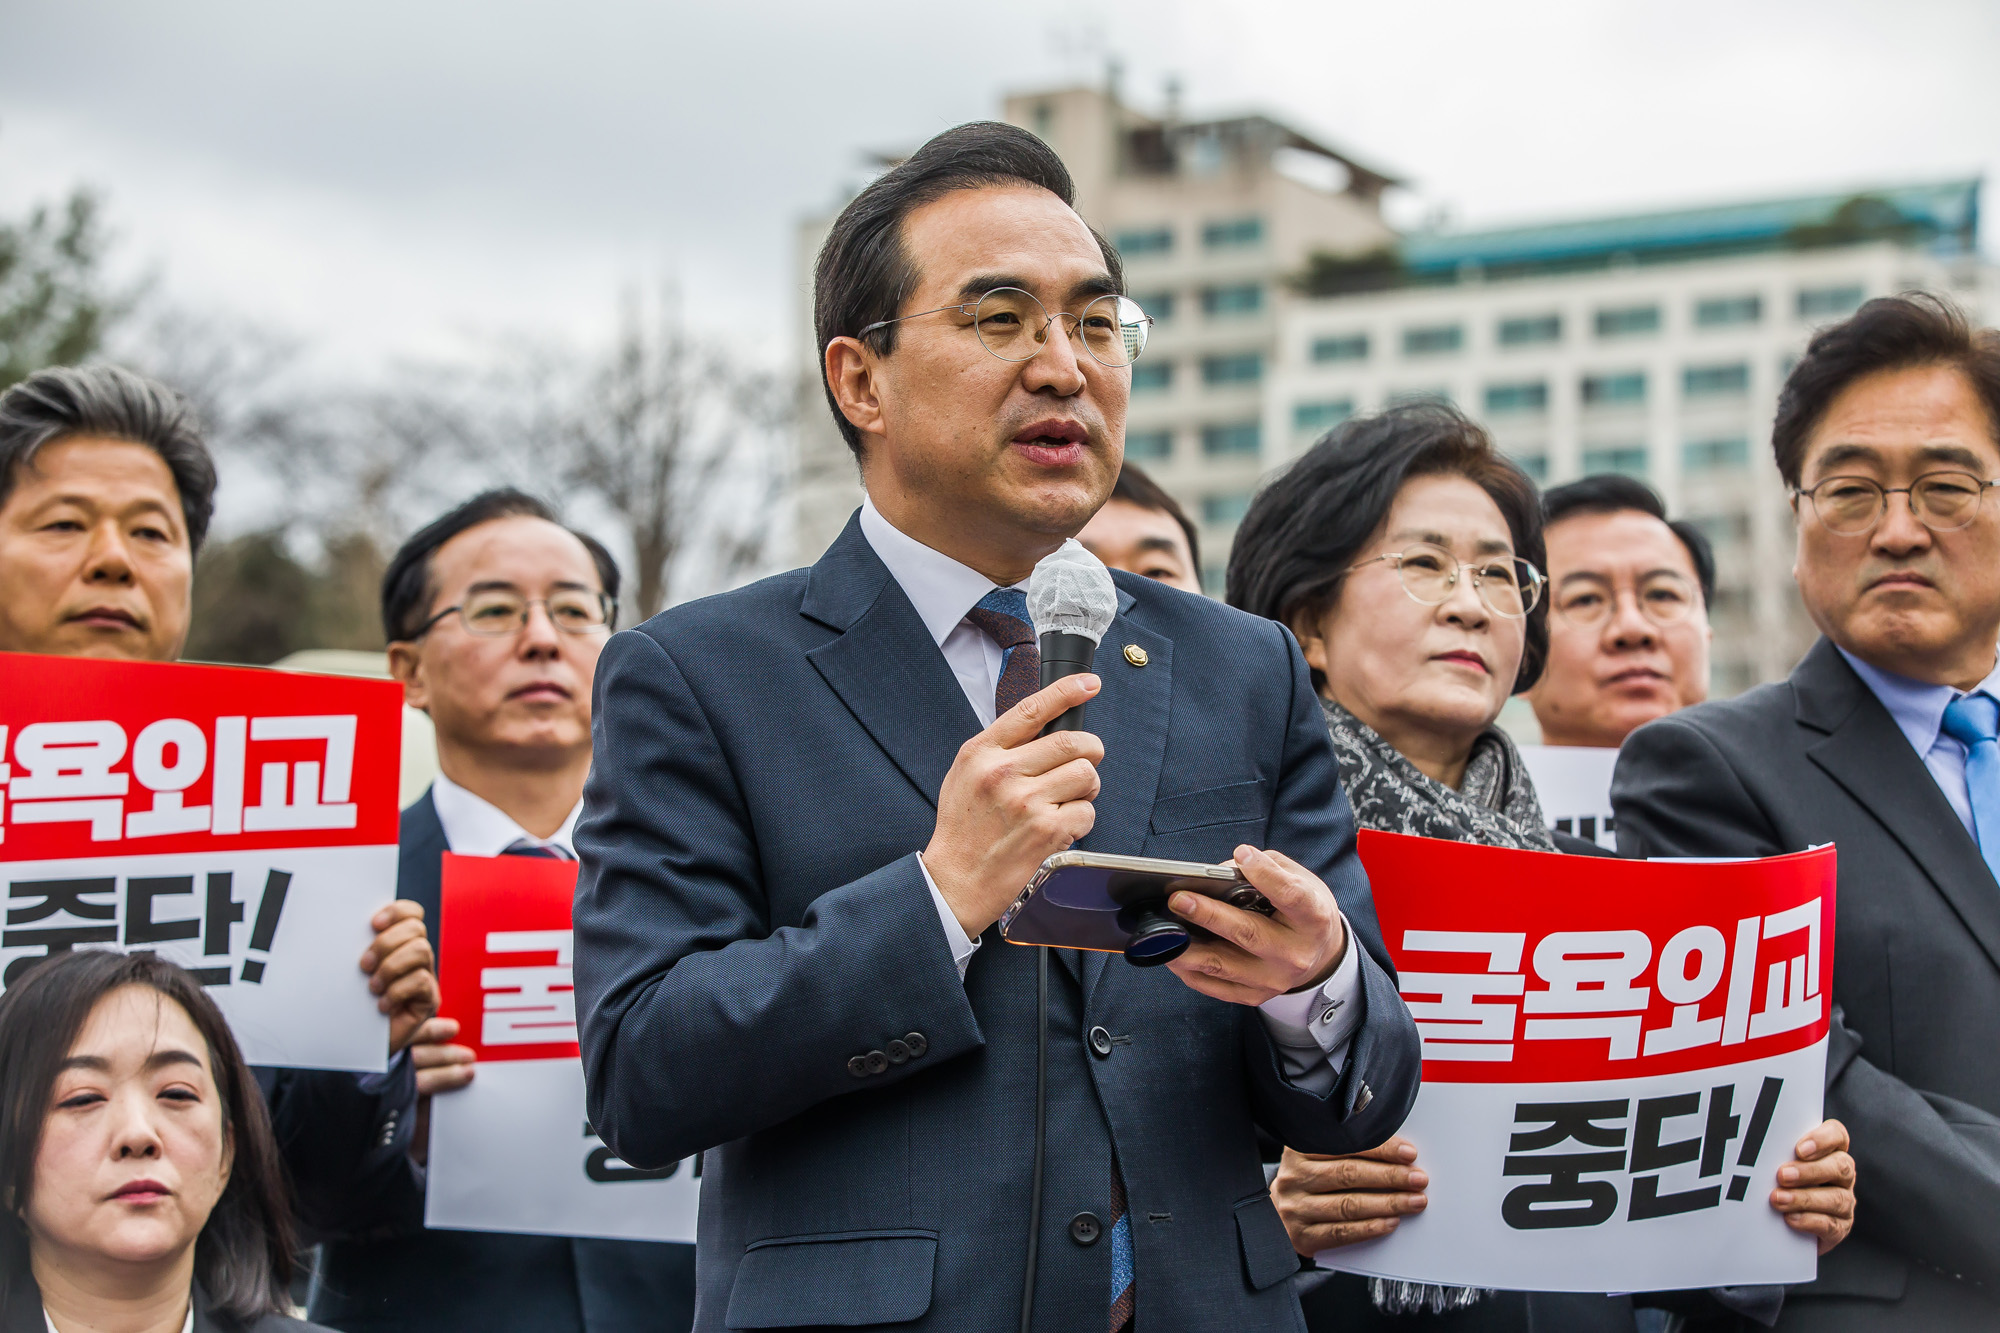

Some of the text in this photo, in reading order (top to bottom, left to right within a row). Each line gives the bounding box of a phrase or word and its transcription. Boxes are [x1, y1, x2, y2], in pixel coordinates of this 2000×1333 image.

[0, 715, 358, 844] 욕외교
[2, 868, 293, 992] 중단!
[1397, 896, 1823, 1062] 굴욕외교
[1501, 1076, 1784, 1230] 중단!
